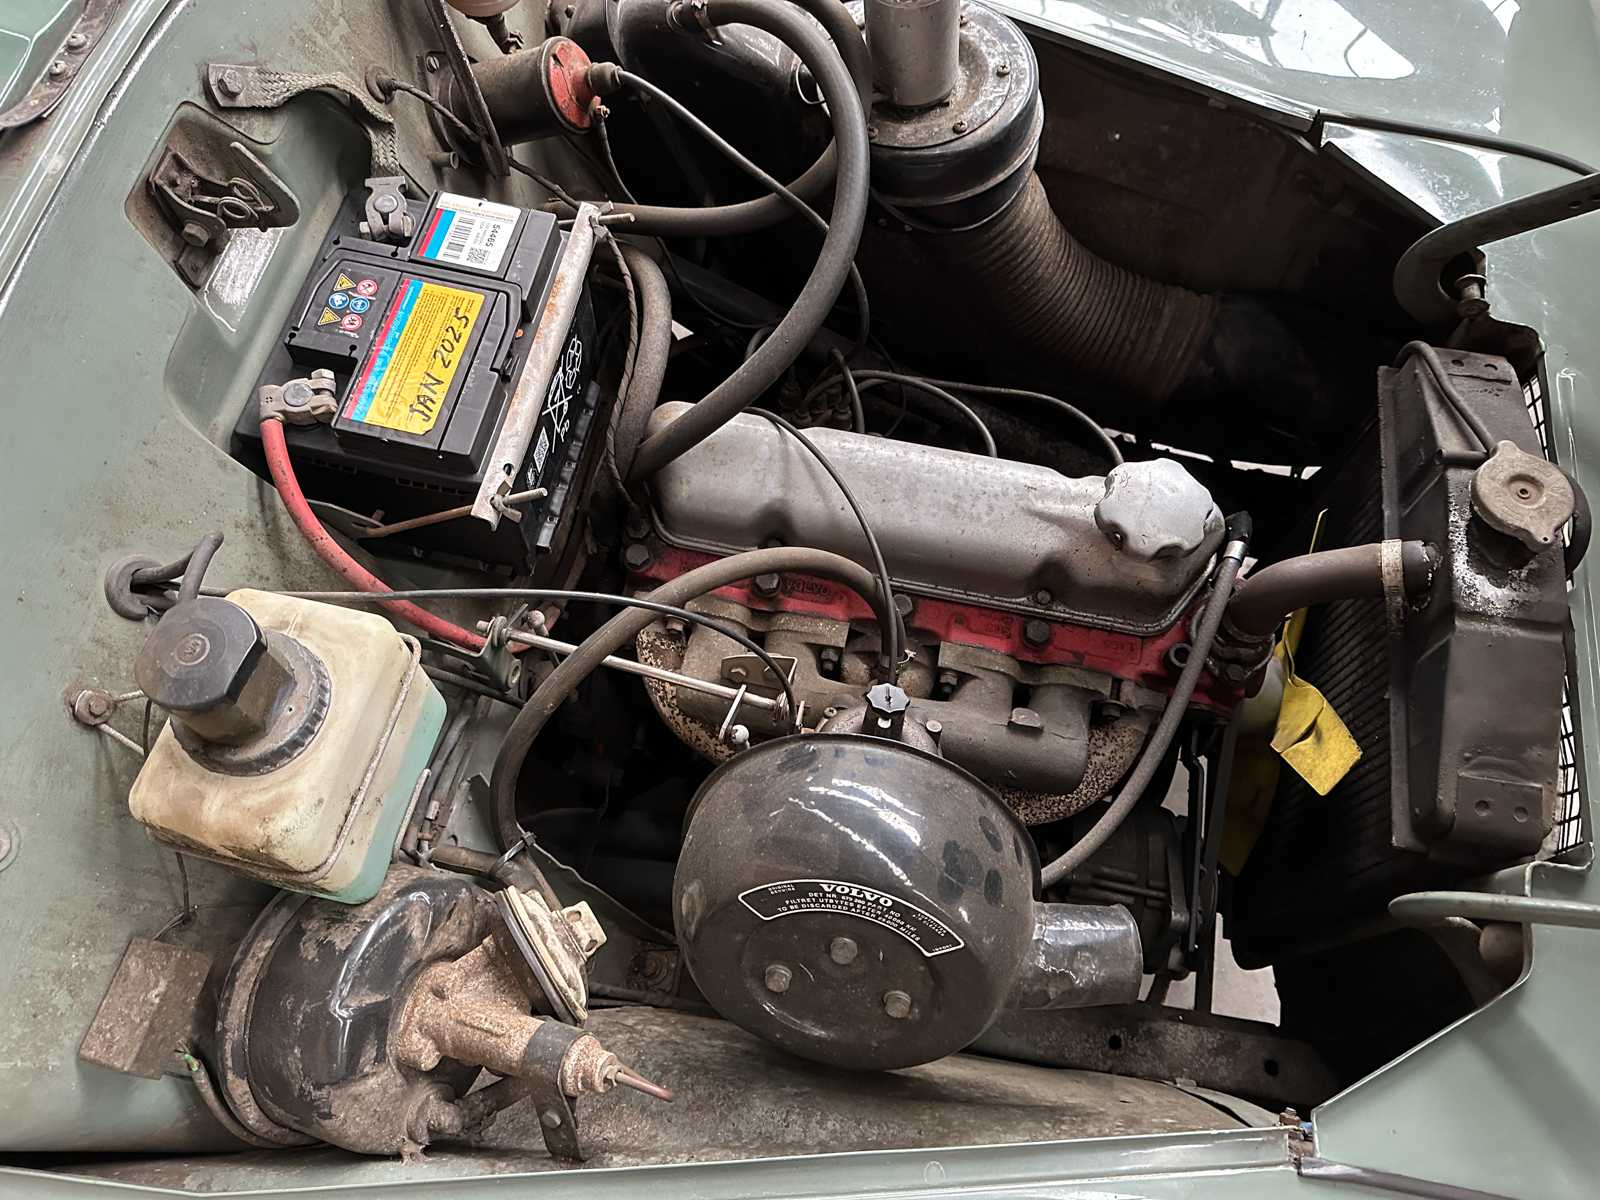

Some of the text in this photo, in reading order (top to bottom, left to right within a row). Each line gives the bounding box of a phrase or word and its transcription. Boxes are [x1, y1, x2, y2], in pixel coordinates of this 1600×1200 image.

[409, 307, 470, 422] JAN 2025
[785, 897, 816, 905] FILTRET
[819, 898, 855, 907] UTBYTES
[857, 904, 882, 915] EFTER
[819, 883, 893, 907] VOLVO
[801, 902, 848, 910] DISCARDED
[850, 907, 876, 918] AFTER
[900, 926, 921, 941] MILES
[867, 901, 887, 912] PART
[890, 910, 901, 918] NO
